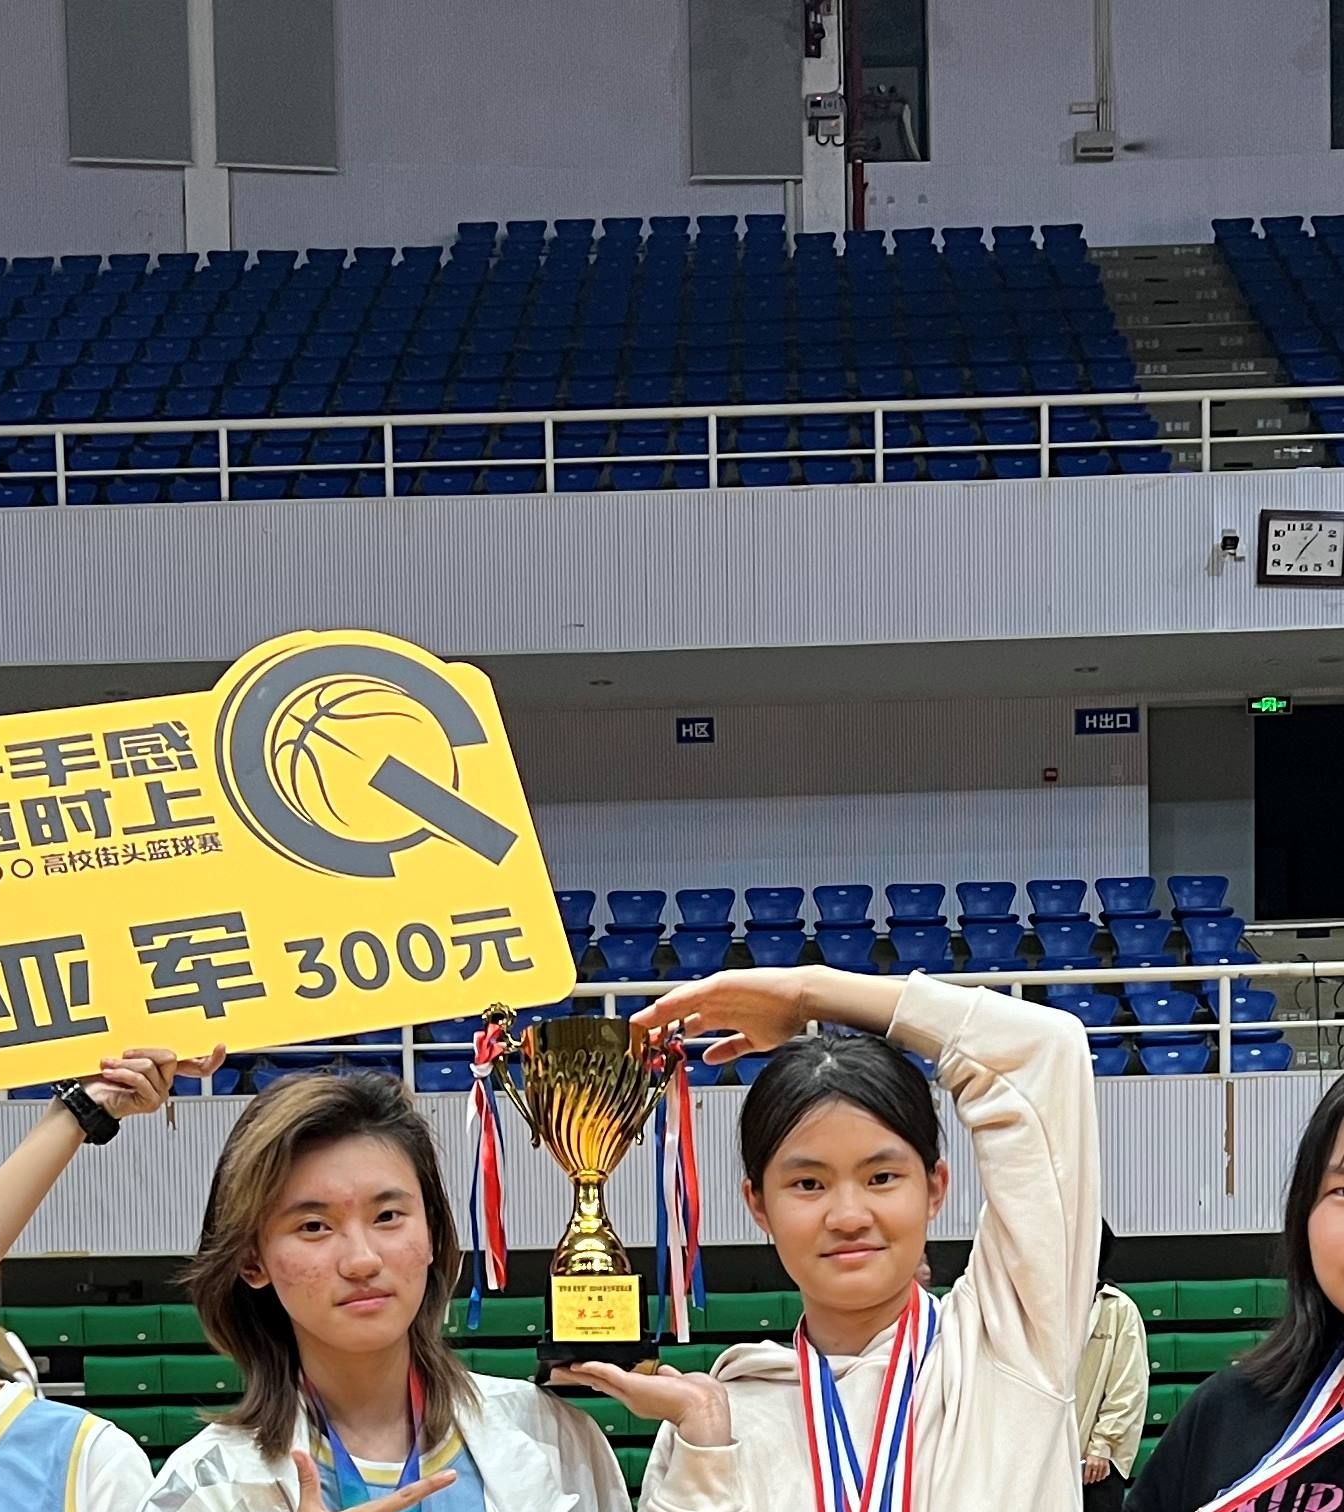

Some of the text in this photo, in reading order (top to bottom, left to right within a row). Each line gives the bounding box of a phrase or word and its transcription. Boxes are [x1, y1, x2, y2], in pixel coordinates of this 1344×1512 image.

[1300, 522, 1313, 531] 12
[1328, 530, 1337, 538] 2
[1285, 563, 1294, 571] 7
[1085, 713, 1131, 729] H出口
[682, 722, 710, 738] H区
[41, 832, 223, 877] 高校街头篮球赛
[285, 907, 534, 998] 300元
